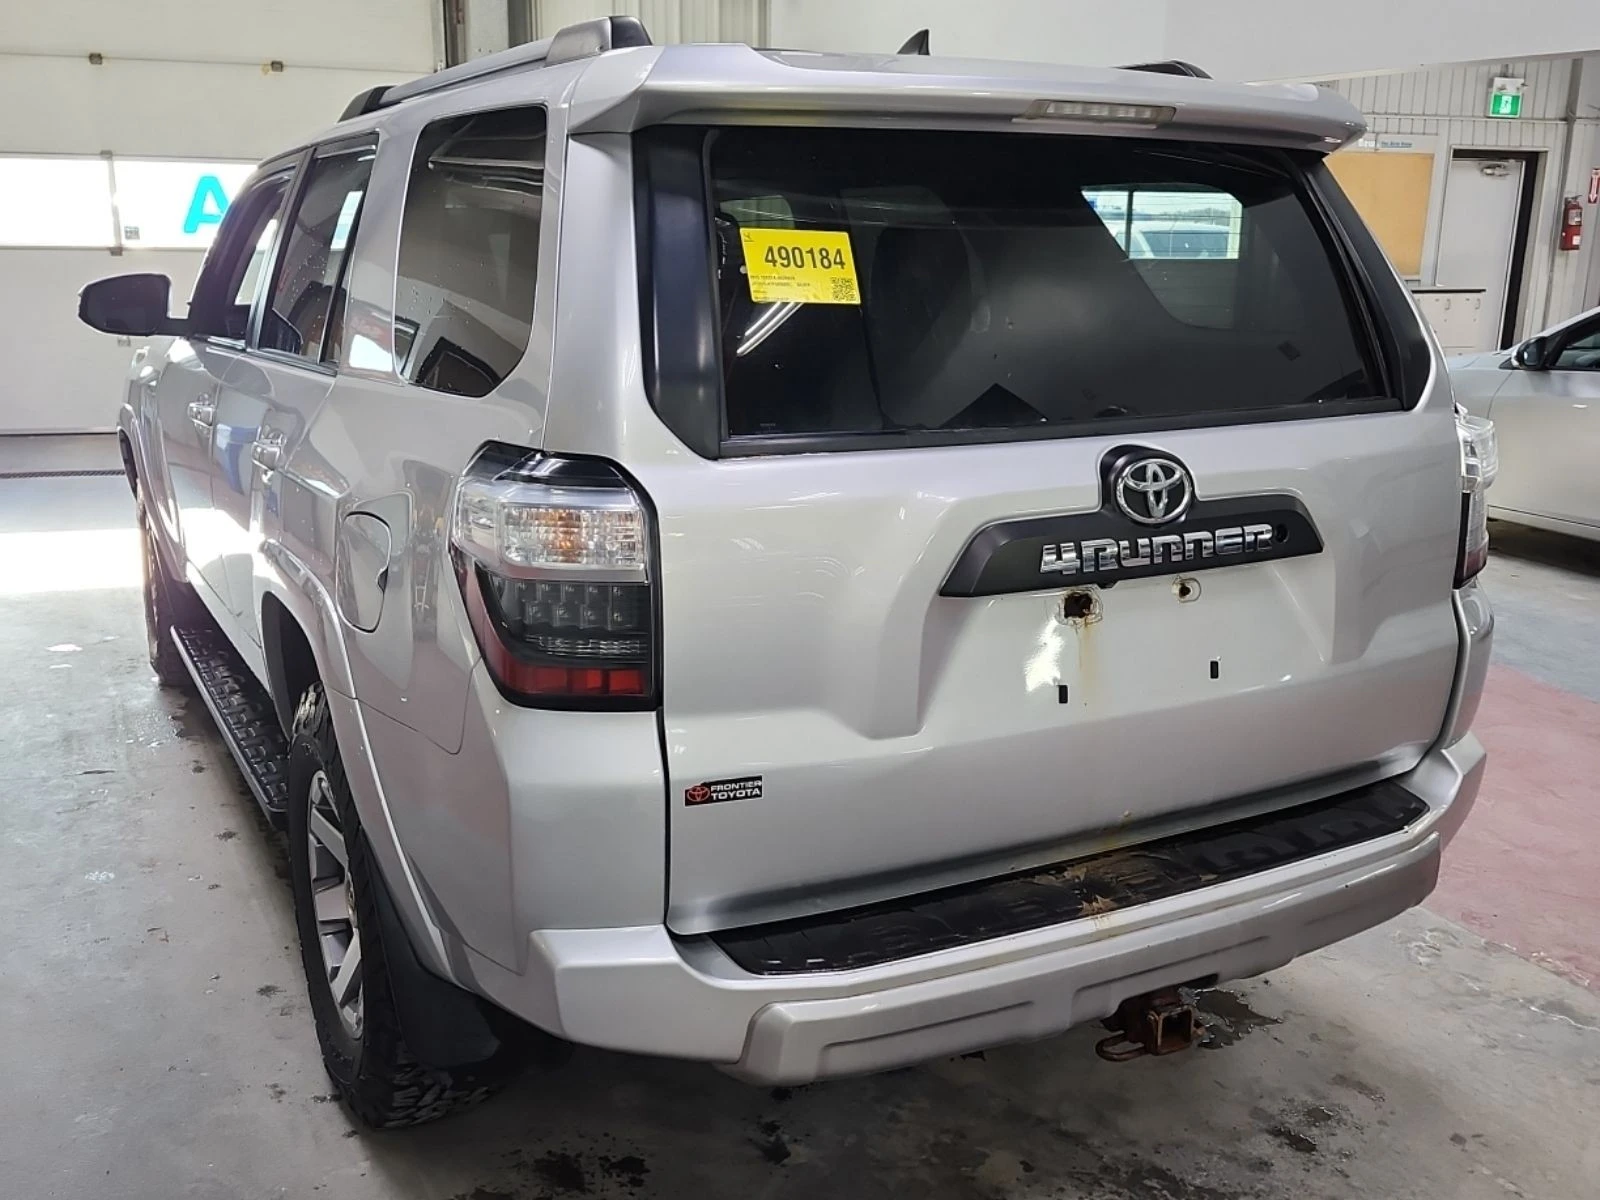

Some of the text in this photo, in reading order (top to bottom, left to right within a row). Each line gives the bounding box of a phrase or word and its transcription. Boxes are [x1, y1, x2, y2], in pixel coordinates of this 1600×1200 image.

[764, 245, 846, 270] 490184
[1040, 523, 1273, 575] 4RUNNER
[710, 780, 762, 792] FRONTIER
[711, 788, 761, 801] TOYOTA
